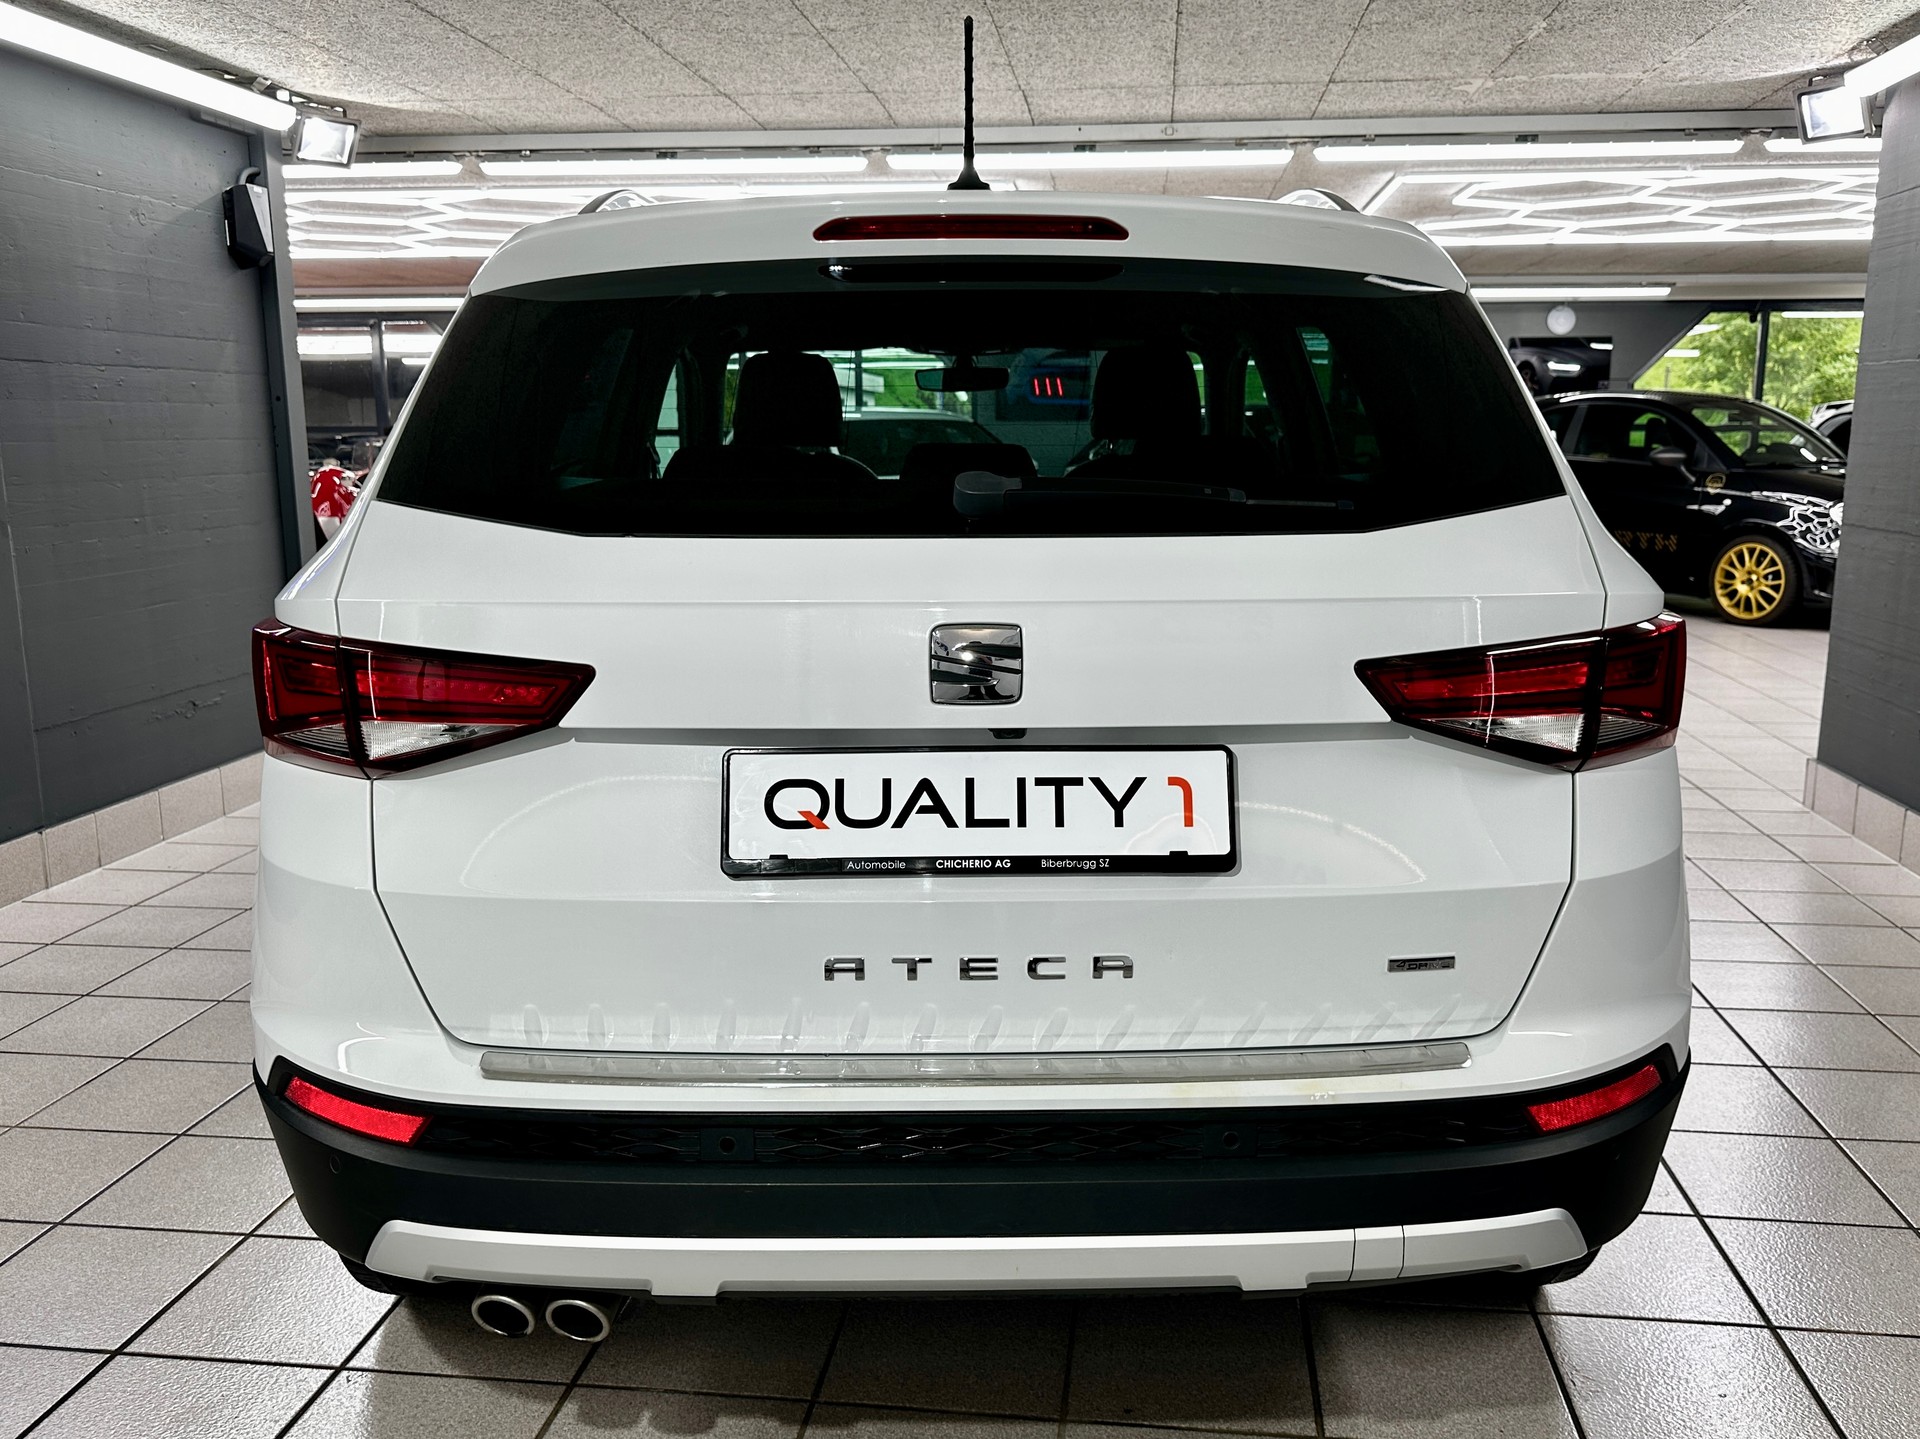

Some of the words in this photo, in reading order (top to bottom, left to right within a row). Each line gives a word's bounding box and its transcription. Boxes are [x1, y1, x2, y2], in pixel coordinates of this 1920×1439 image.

[763, 776, 1147, 830] QUALITY
[1167, 776, 1194, 828] 1
[846, 859, 907, 870] Automobile
[935, 859, 992, 869] CHICHERIO
[994, 859, 1012, 869] AG
[1041, 858, 1097, 870] Biberbrugg
[1099, 858, 1110, 868] SZ
[823, 954, 1134, 981] ATECA
